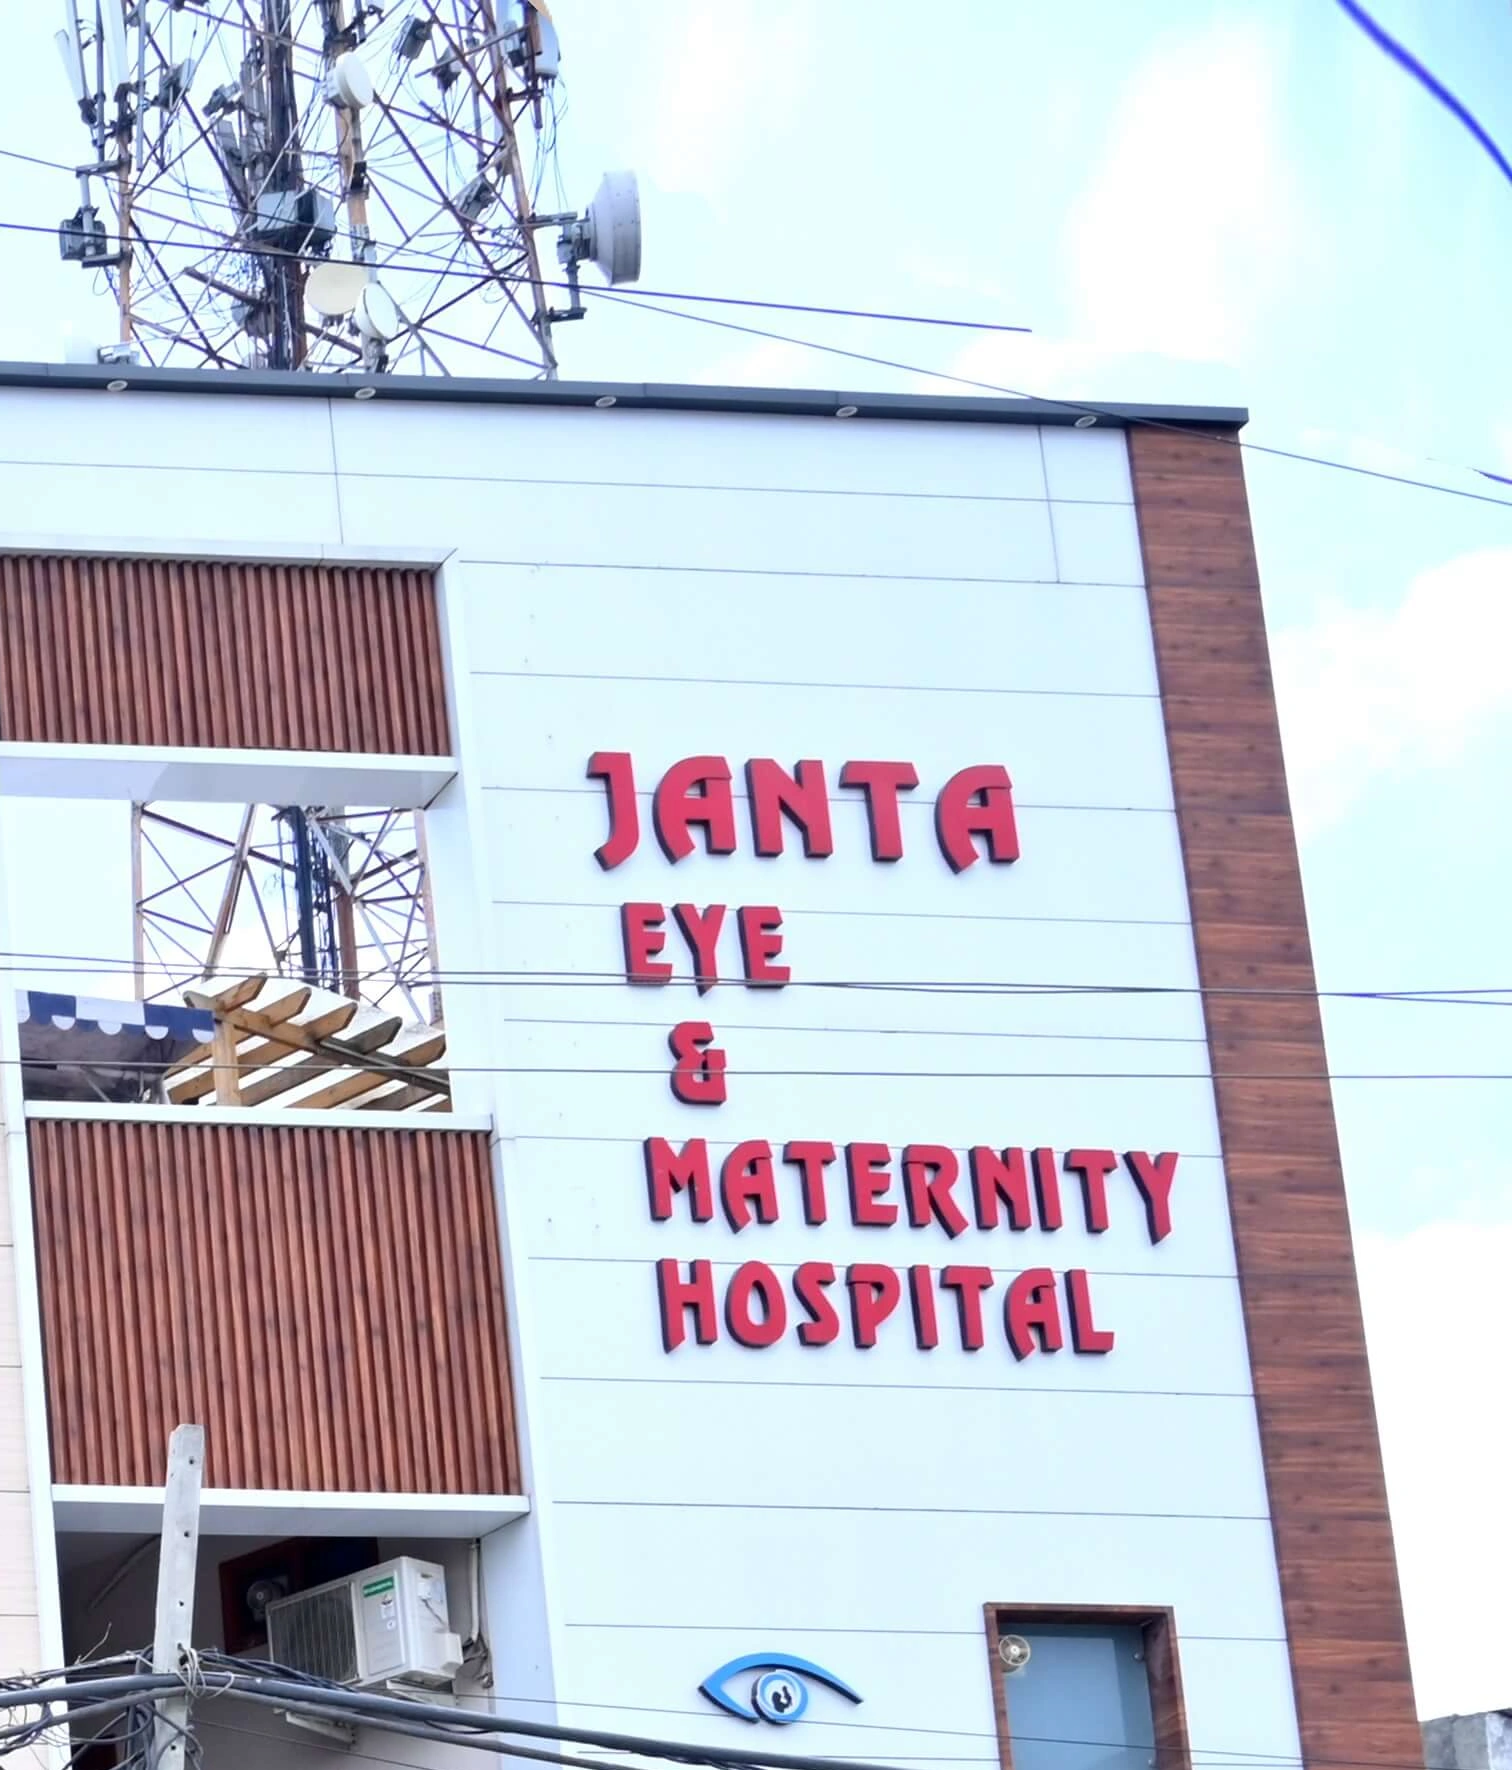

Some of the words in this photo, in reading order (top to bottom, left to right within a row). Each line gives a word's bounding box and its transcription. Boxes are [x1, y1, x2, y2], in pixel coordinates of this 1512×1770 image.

[588, 751, 1020, 873] JANTA
[621, 902, 791, 995] EYE
[668, 1022, 726, 1106] &
[645, 1137, 1179, 1245] MATERNITY
[655, 1258, 1115, 1362] HOSPITAL
